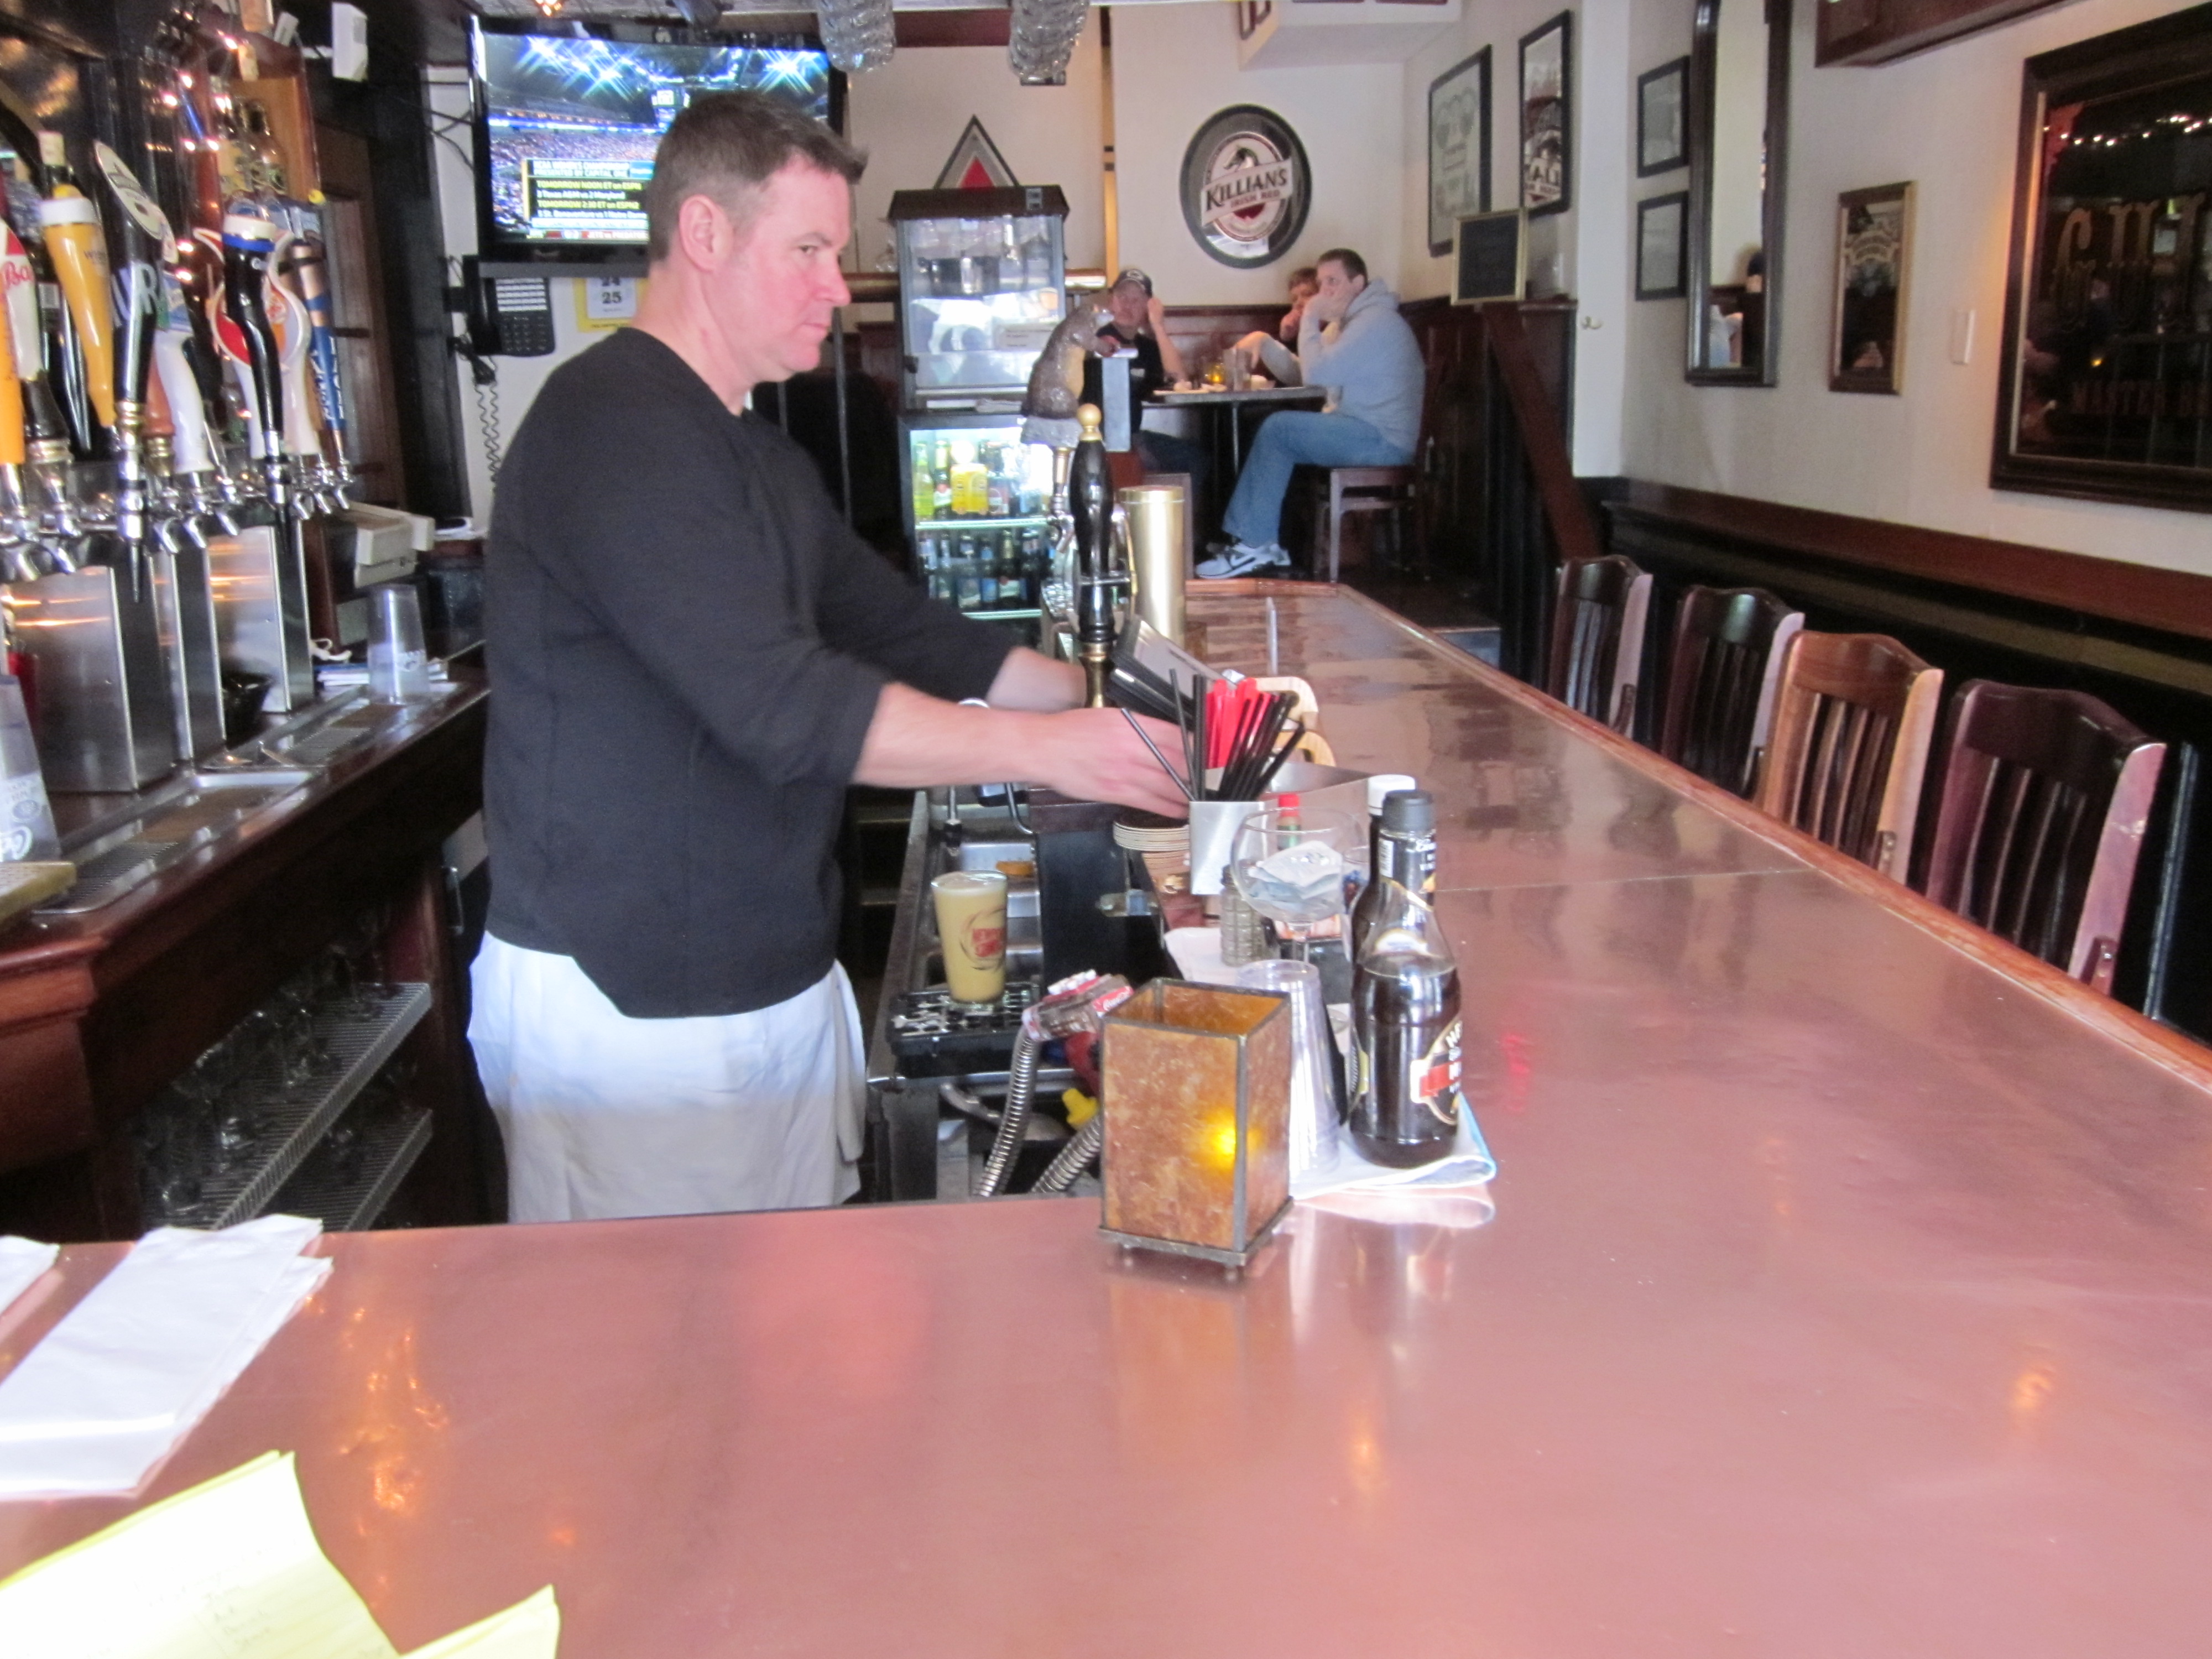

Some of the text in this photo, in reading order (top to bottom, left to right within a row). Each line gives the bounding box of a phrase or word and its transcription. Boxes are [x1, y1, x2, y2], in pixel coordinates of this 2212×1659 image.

[537, 180, 581, 189] TOMORROW
[581, 181, 603, 189] NOON
[538, 200, 581, 208] TOMORROW
[602, 291, 622, 304] 25
